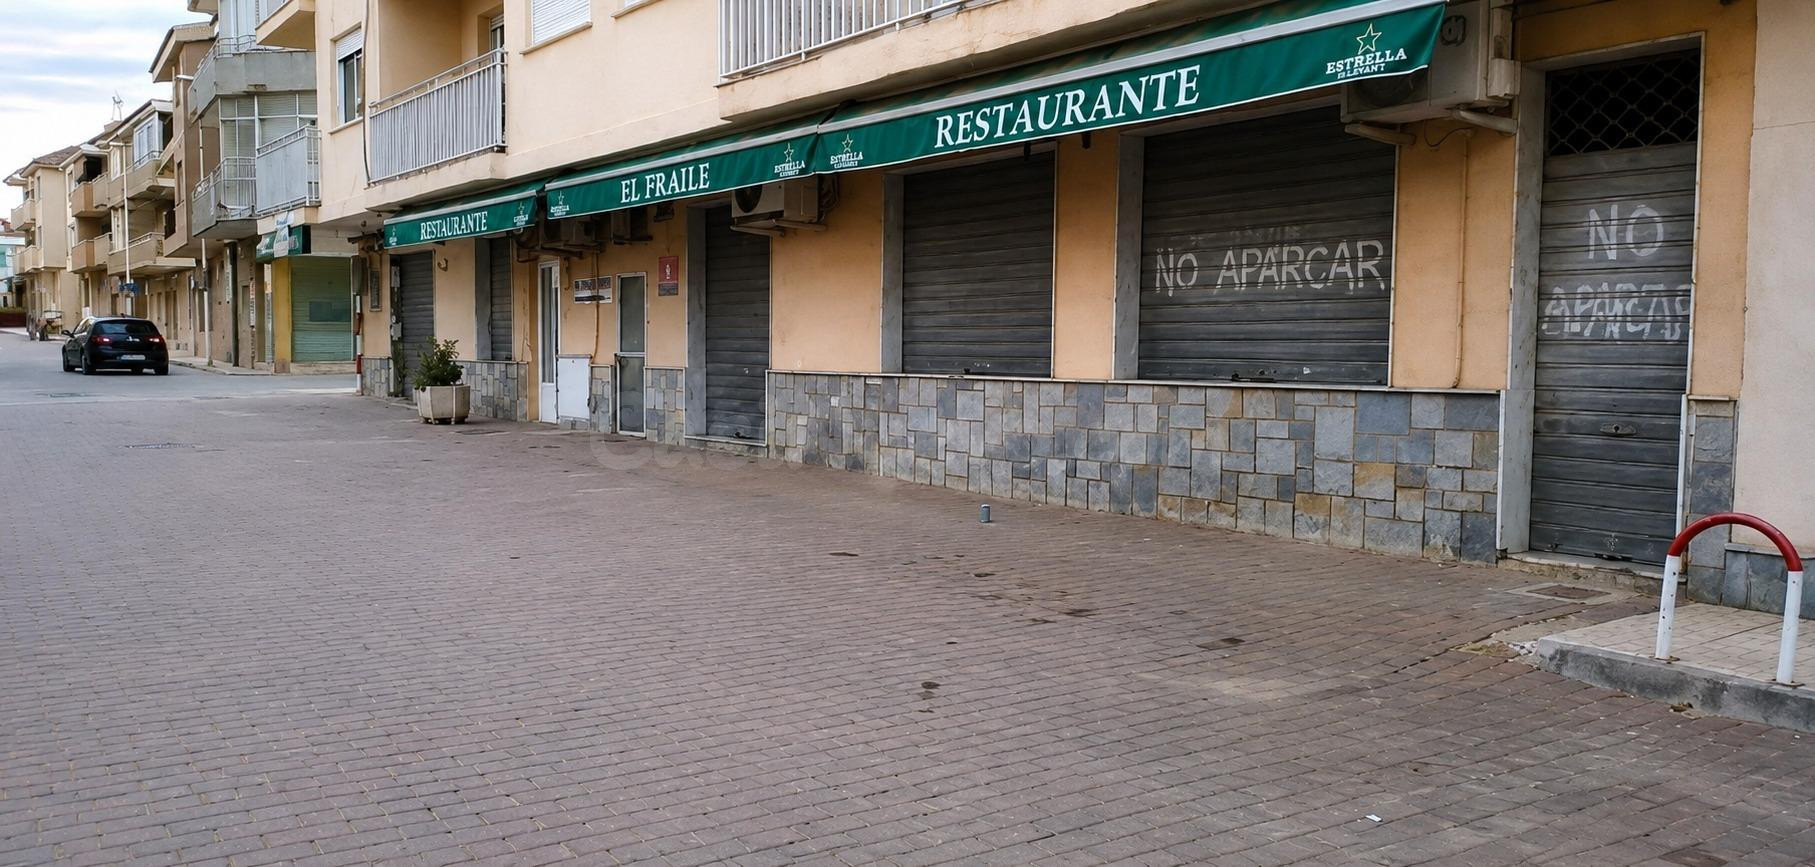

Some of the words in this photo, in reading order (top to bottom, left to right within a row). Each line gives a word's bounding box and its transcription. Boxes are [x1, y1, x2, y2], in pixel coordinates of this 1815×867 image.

[1325, 47, 1408, 75] ESTRELLA
[934, 64, 1201, 149] RESTAURANTE
[774, 160, 806, 174] ESTRELLA
[829, 151, 864, 165] ESTRELLA
[620, 178, 640, 204] EL
[644, 162, 710, 199] FRAILE
[420, 211, 488, 241] RESTAURANTE
[1587, 203, 1665, 261] NO
[1155, 247, 1199, 297] NO
[1213, 238, 1386, 295] APARCAR
